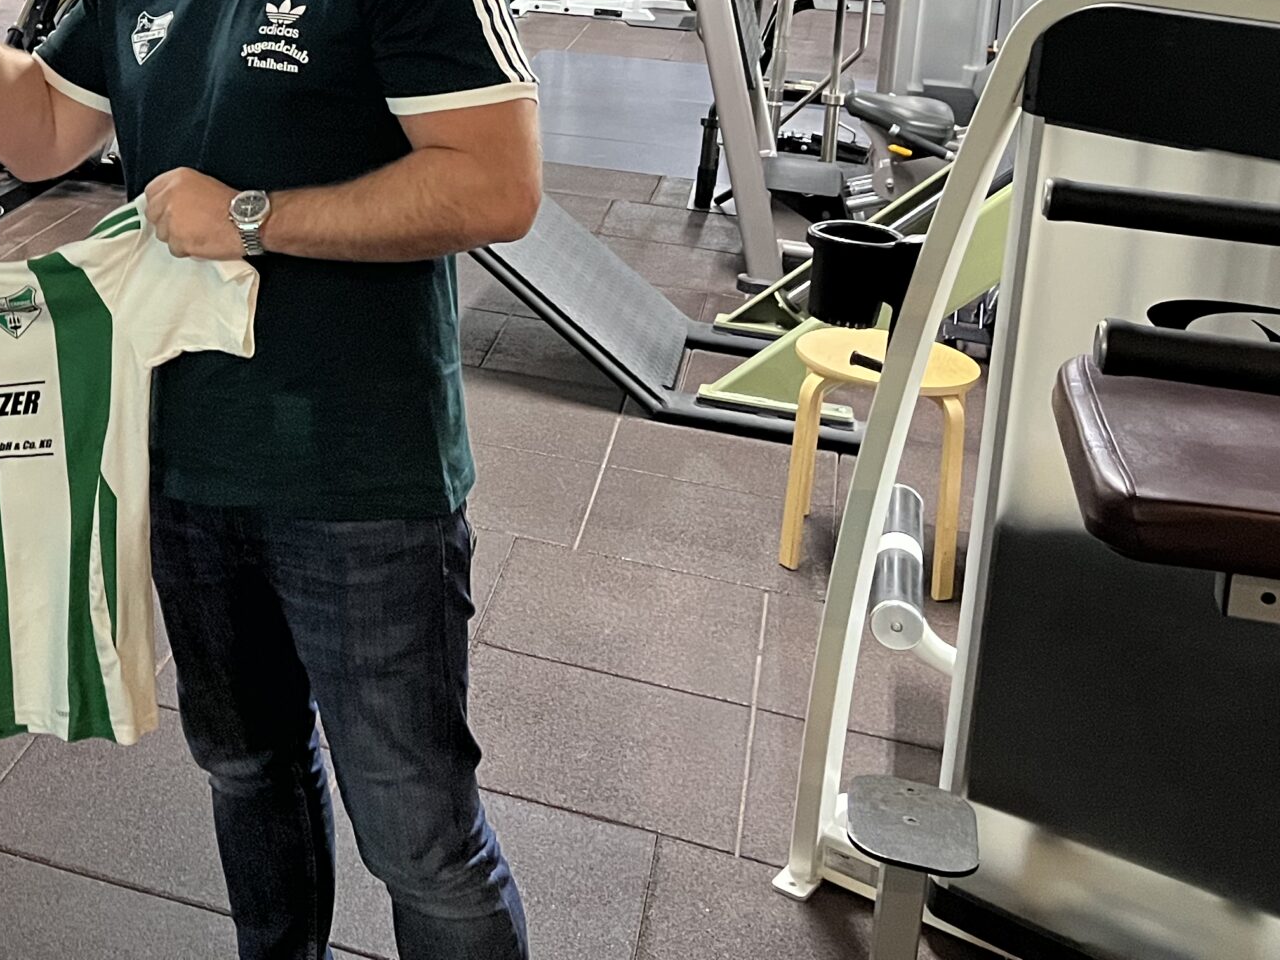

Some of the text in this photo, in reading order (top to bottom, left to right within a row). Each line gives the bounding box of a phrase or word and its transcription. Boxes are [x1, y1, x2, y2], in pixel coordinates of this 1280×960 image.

[258, 24, 300, 39] adidas
[241, 40, 310, 64] Jugendclub
[246, 56, 299, 74] Thalheim
[14, 442, 21, 450] &
[23, 440, 36, 450] Co.
[39, 439, 53, 448] KG
